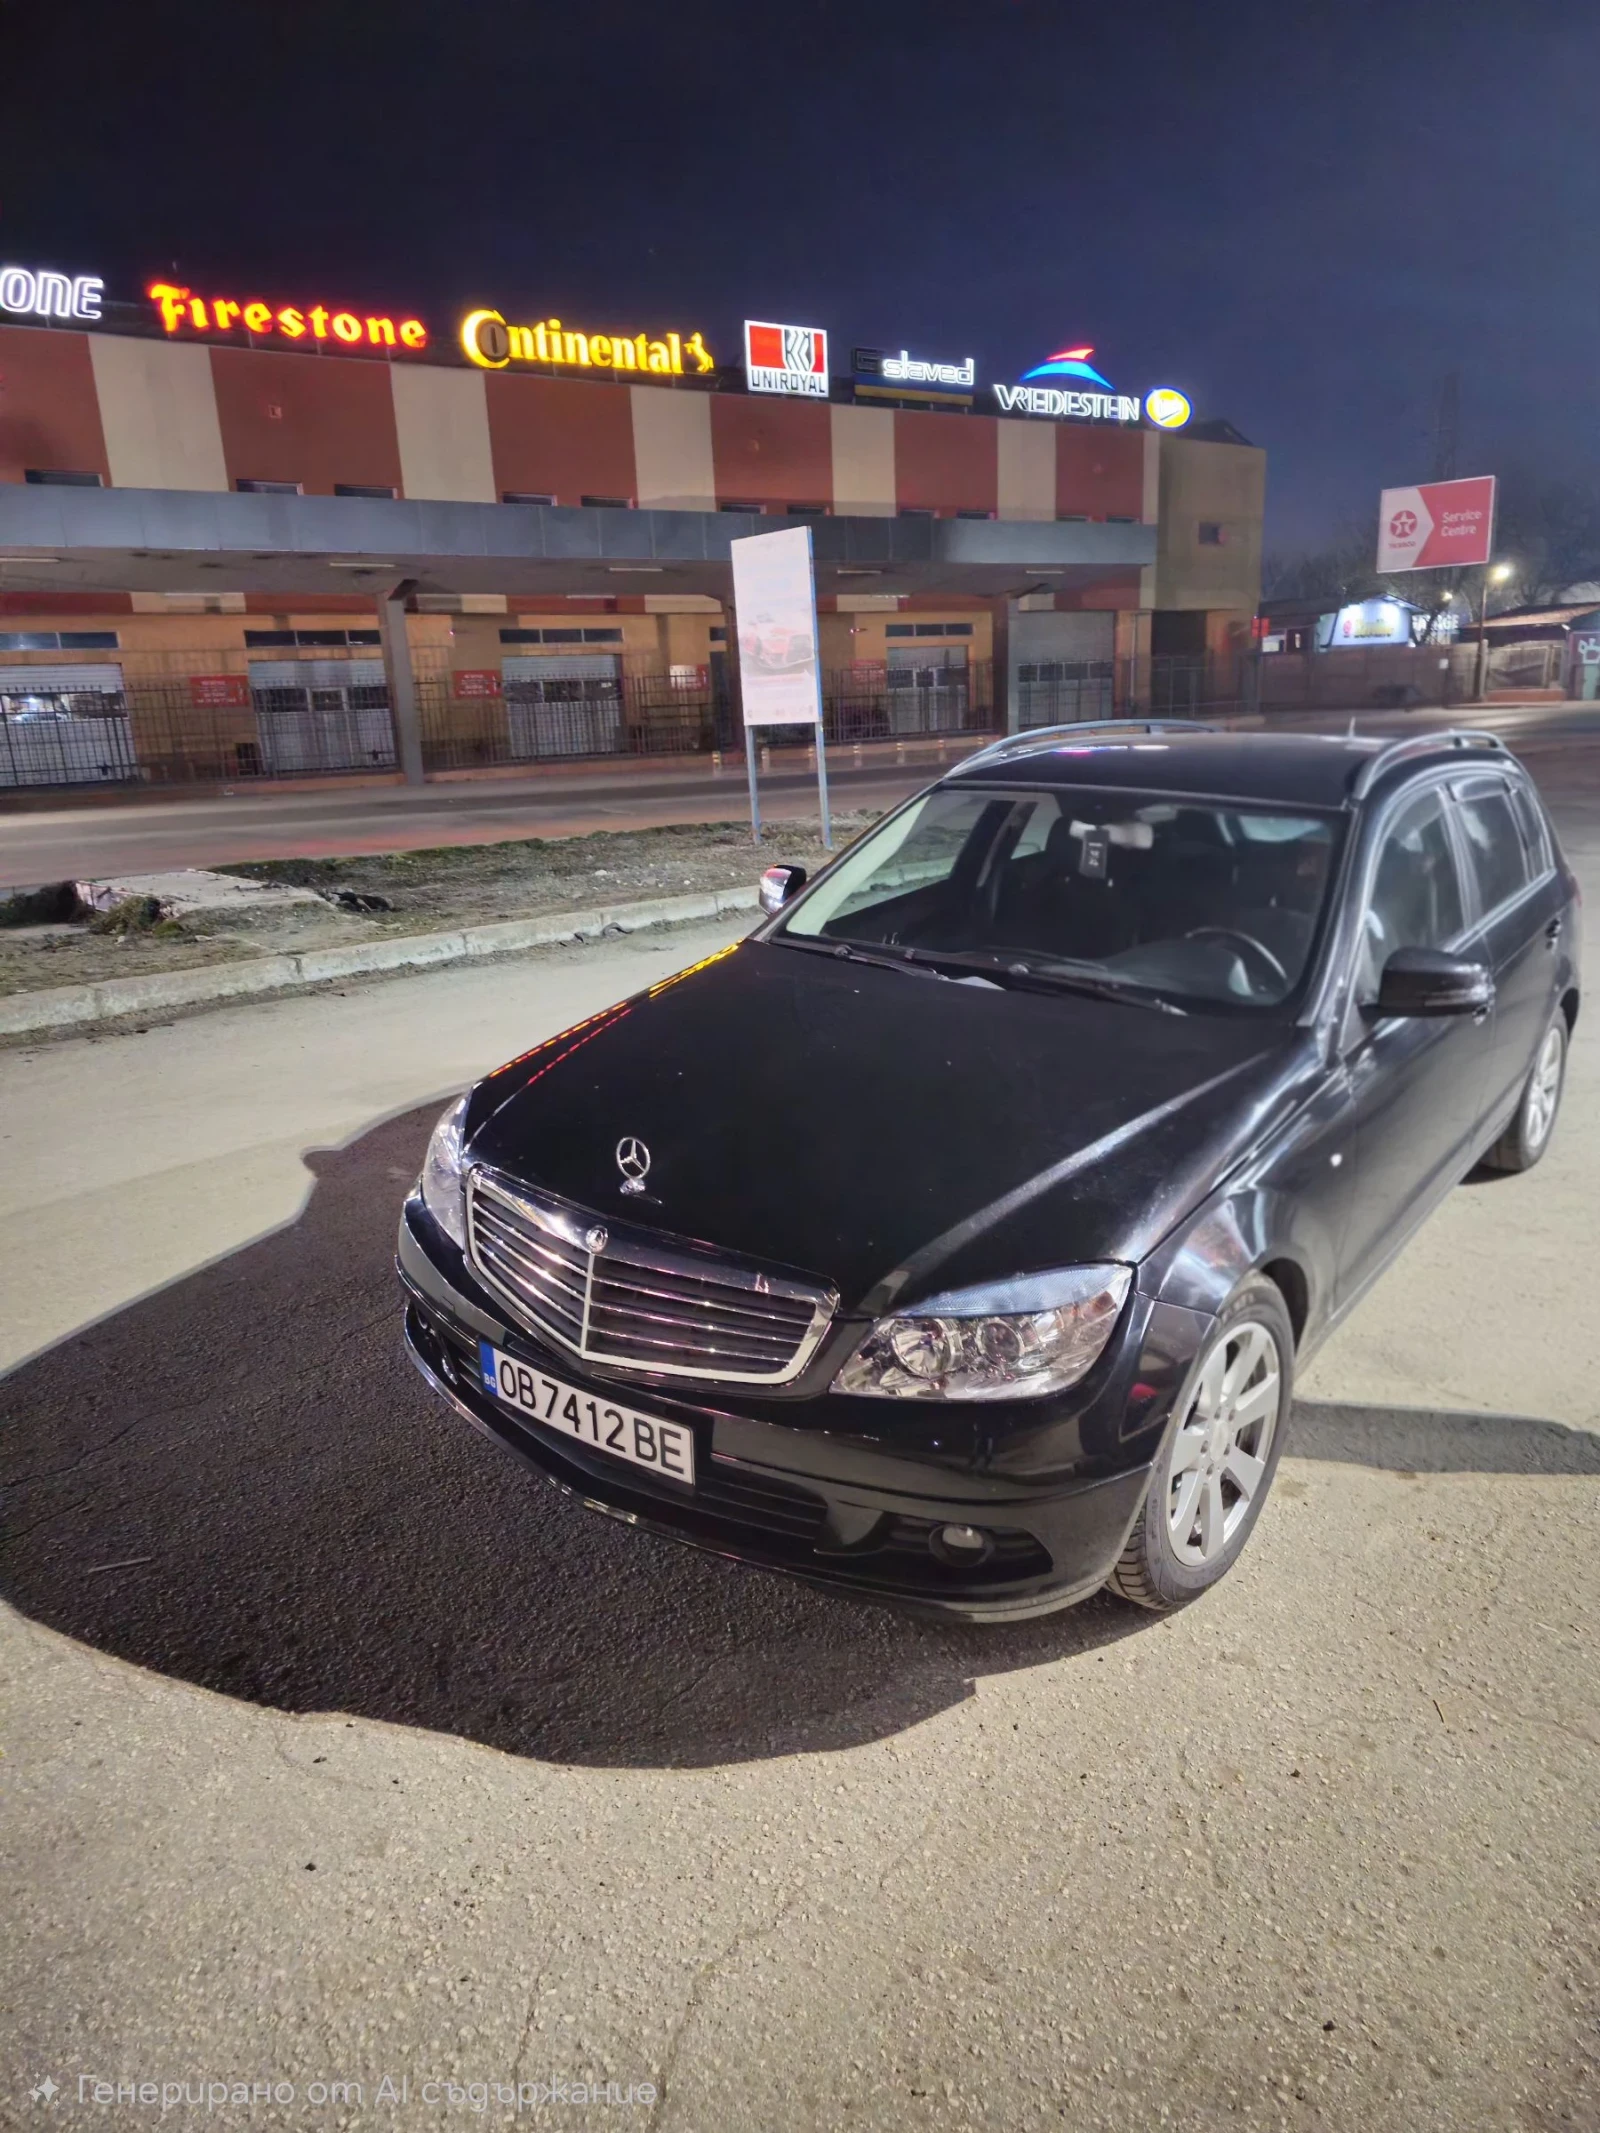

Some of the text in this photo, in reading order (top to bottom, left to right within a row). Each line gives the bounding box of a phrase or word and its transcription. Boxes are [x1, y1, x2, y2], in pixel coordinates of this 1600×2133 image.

[149, 283, 427, 348] Firestone
[462, 309, 684, 374] Continental
[751, 369, 826, 393] UNIROYAL
[484, 1372, 497, 1388] BG
